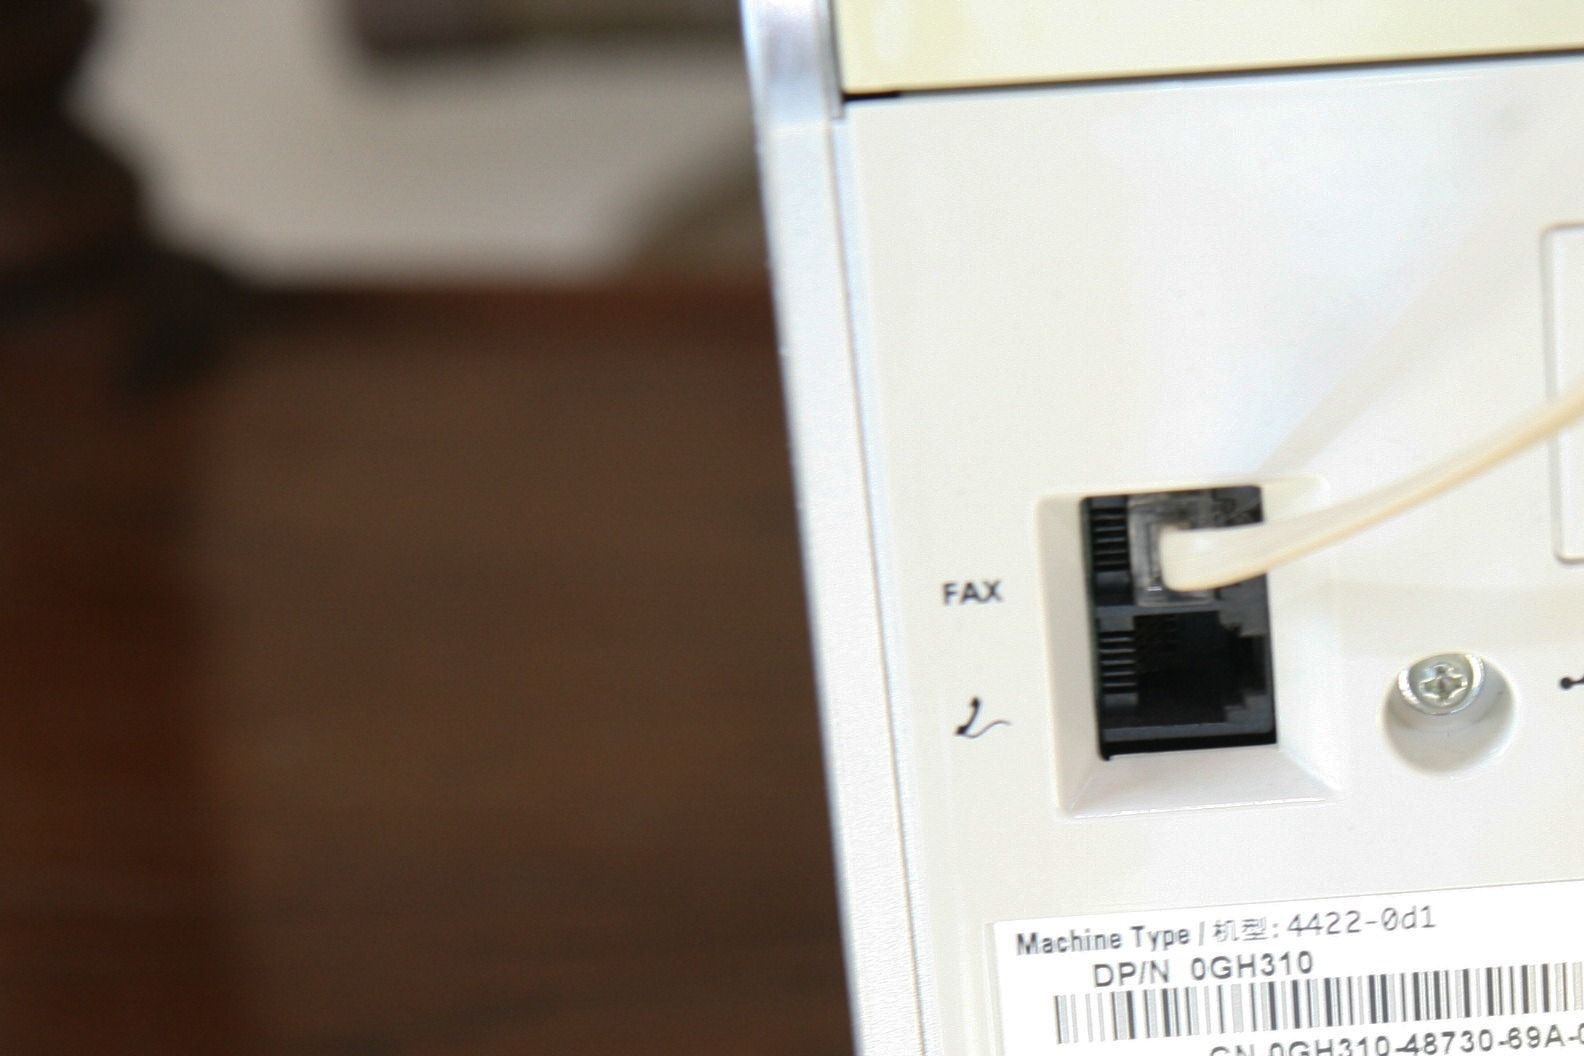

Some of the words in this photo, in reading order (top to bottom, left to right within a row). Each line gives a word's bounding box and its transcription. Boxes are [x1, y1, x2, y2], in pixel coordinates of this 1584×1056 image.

[942, 580, 1003, 605] FAX
[1017, 930, 1122, 956] Machine
[1131, 925, 1190, 952] Type
[1093, 959, 1170, 989] DP/N
[1190, 950, 1314, 982] 0GH310
